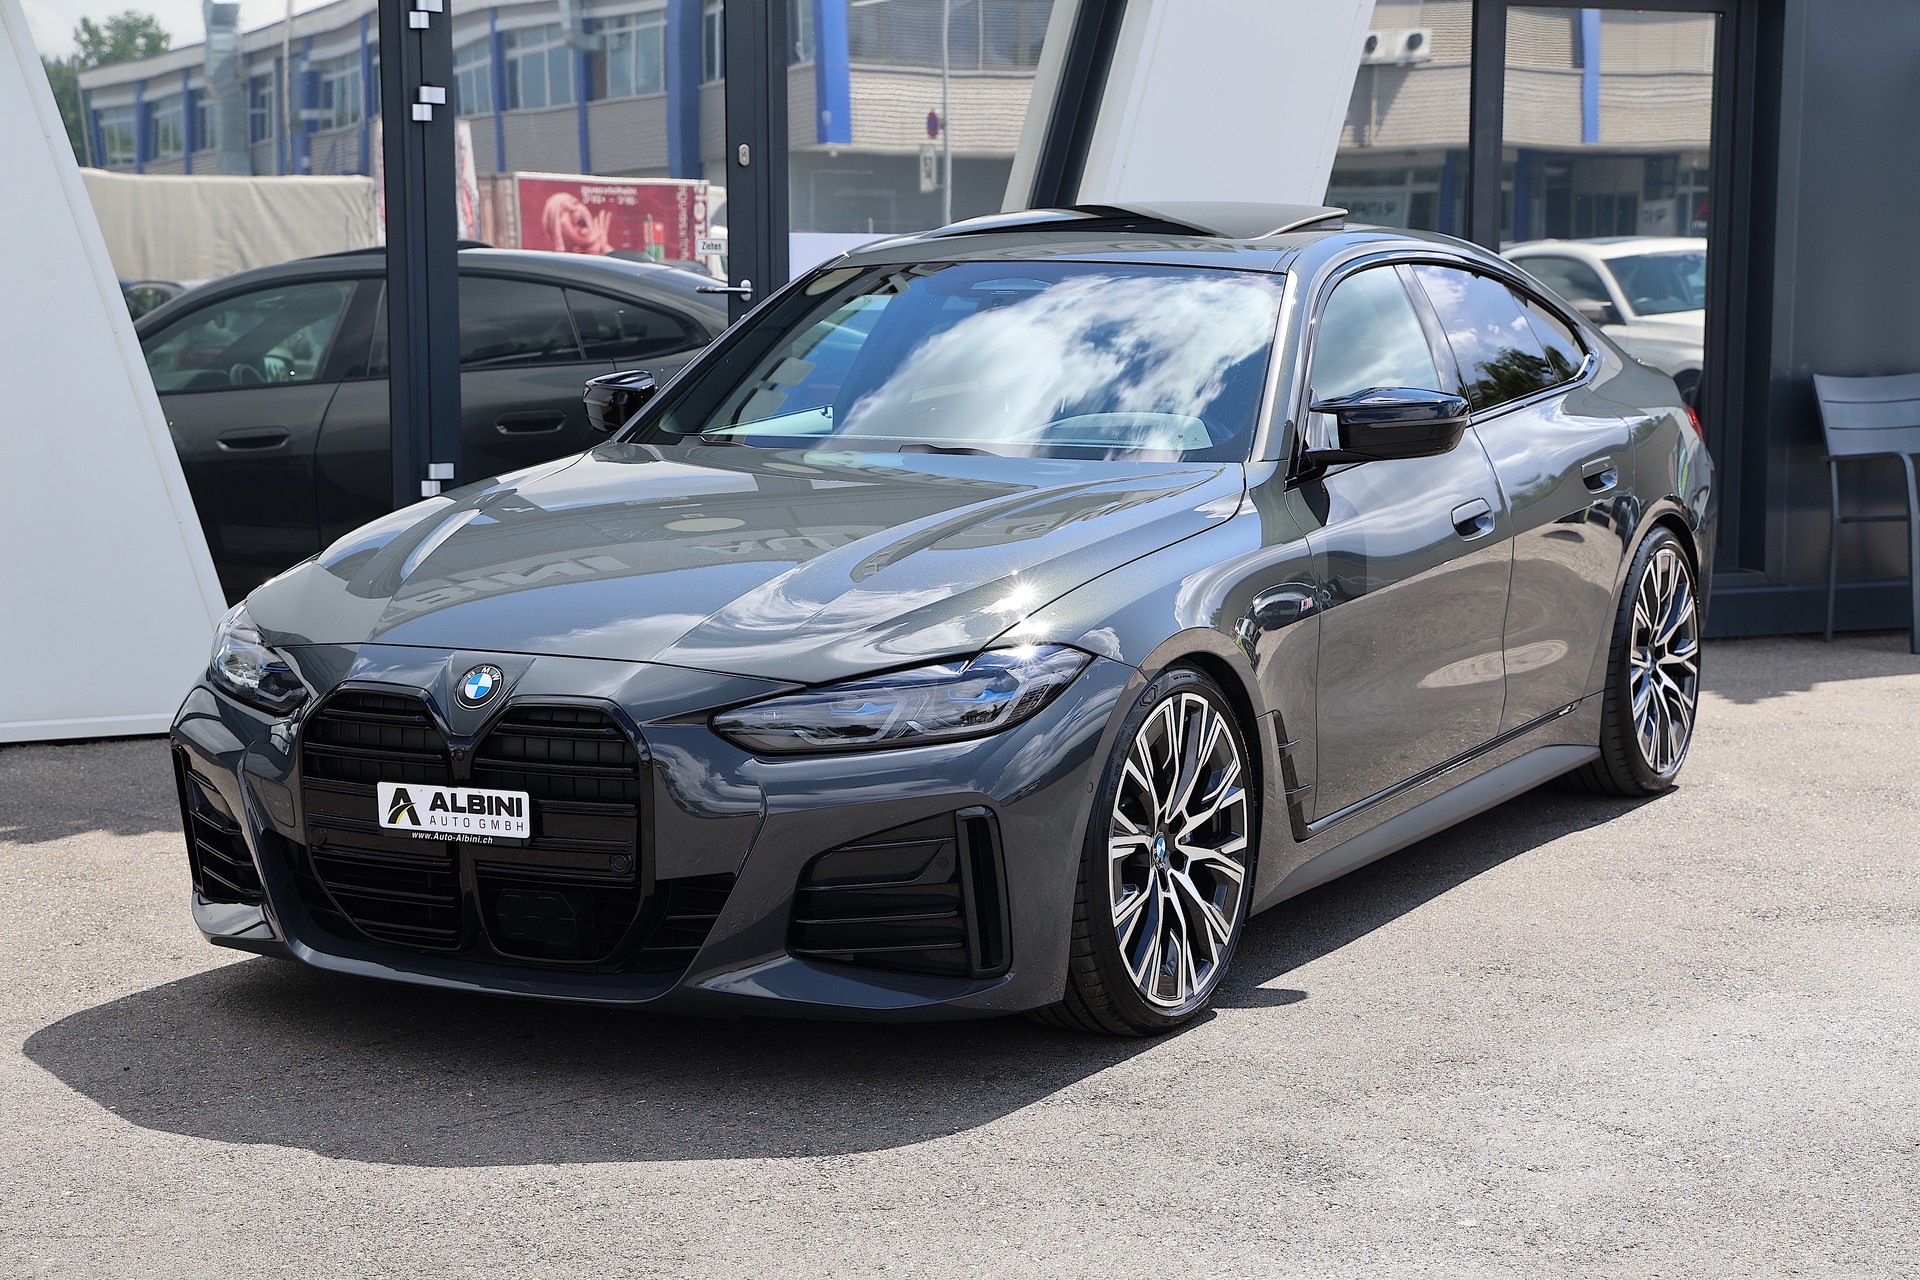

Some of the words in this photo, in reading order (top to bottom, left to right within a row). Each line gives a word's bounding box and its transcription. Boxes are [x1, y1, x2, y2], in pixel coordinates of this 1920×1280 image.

[701, 241, 722, 250] Ziehen
[467, 666, 500, 681] BMW
[429, 792, 523, 818] ALBINI
[429, 815, 471, 828] AUTO
[479, 818, 524, 832] GMBH
[411, 831, 494, 844] www.Auto-Albini.ch
